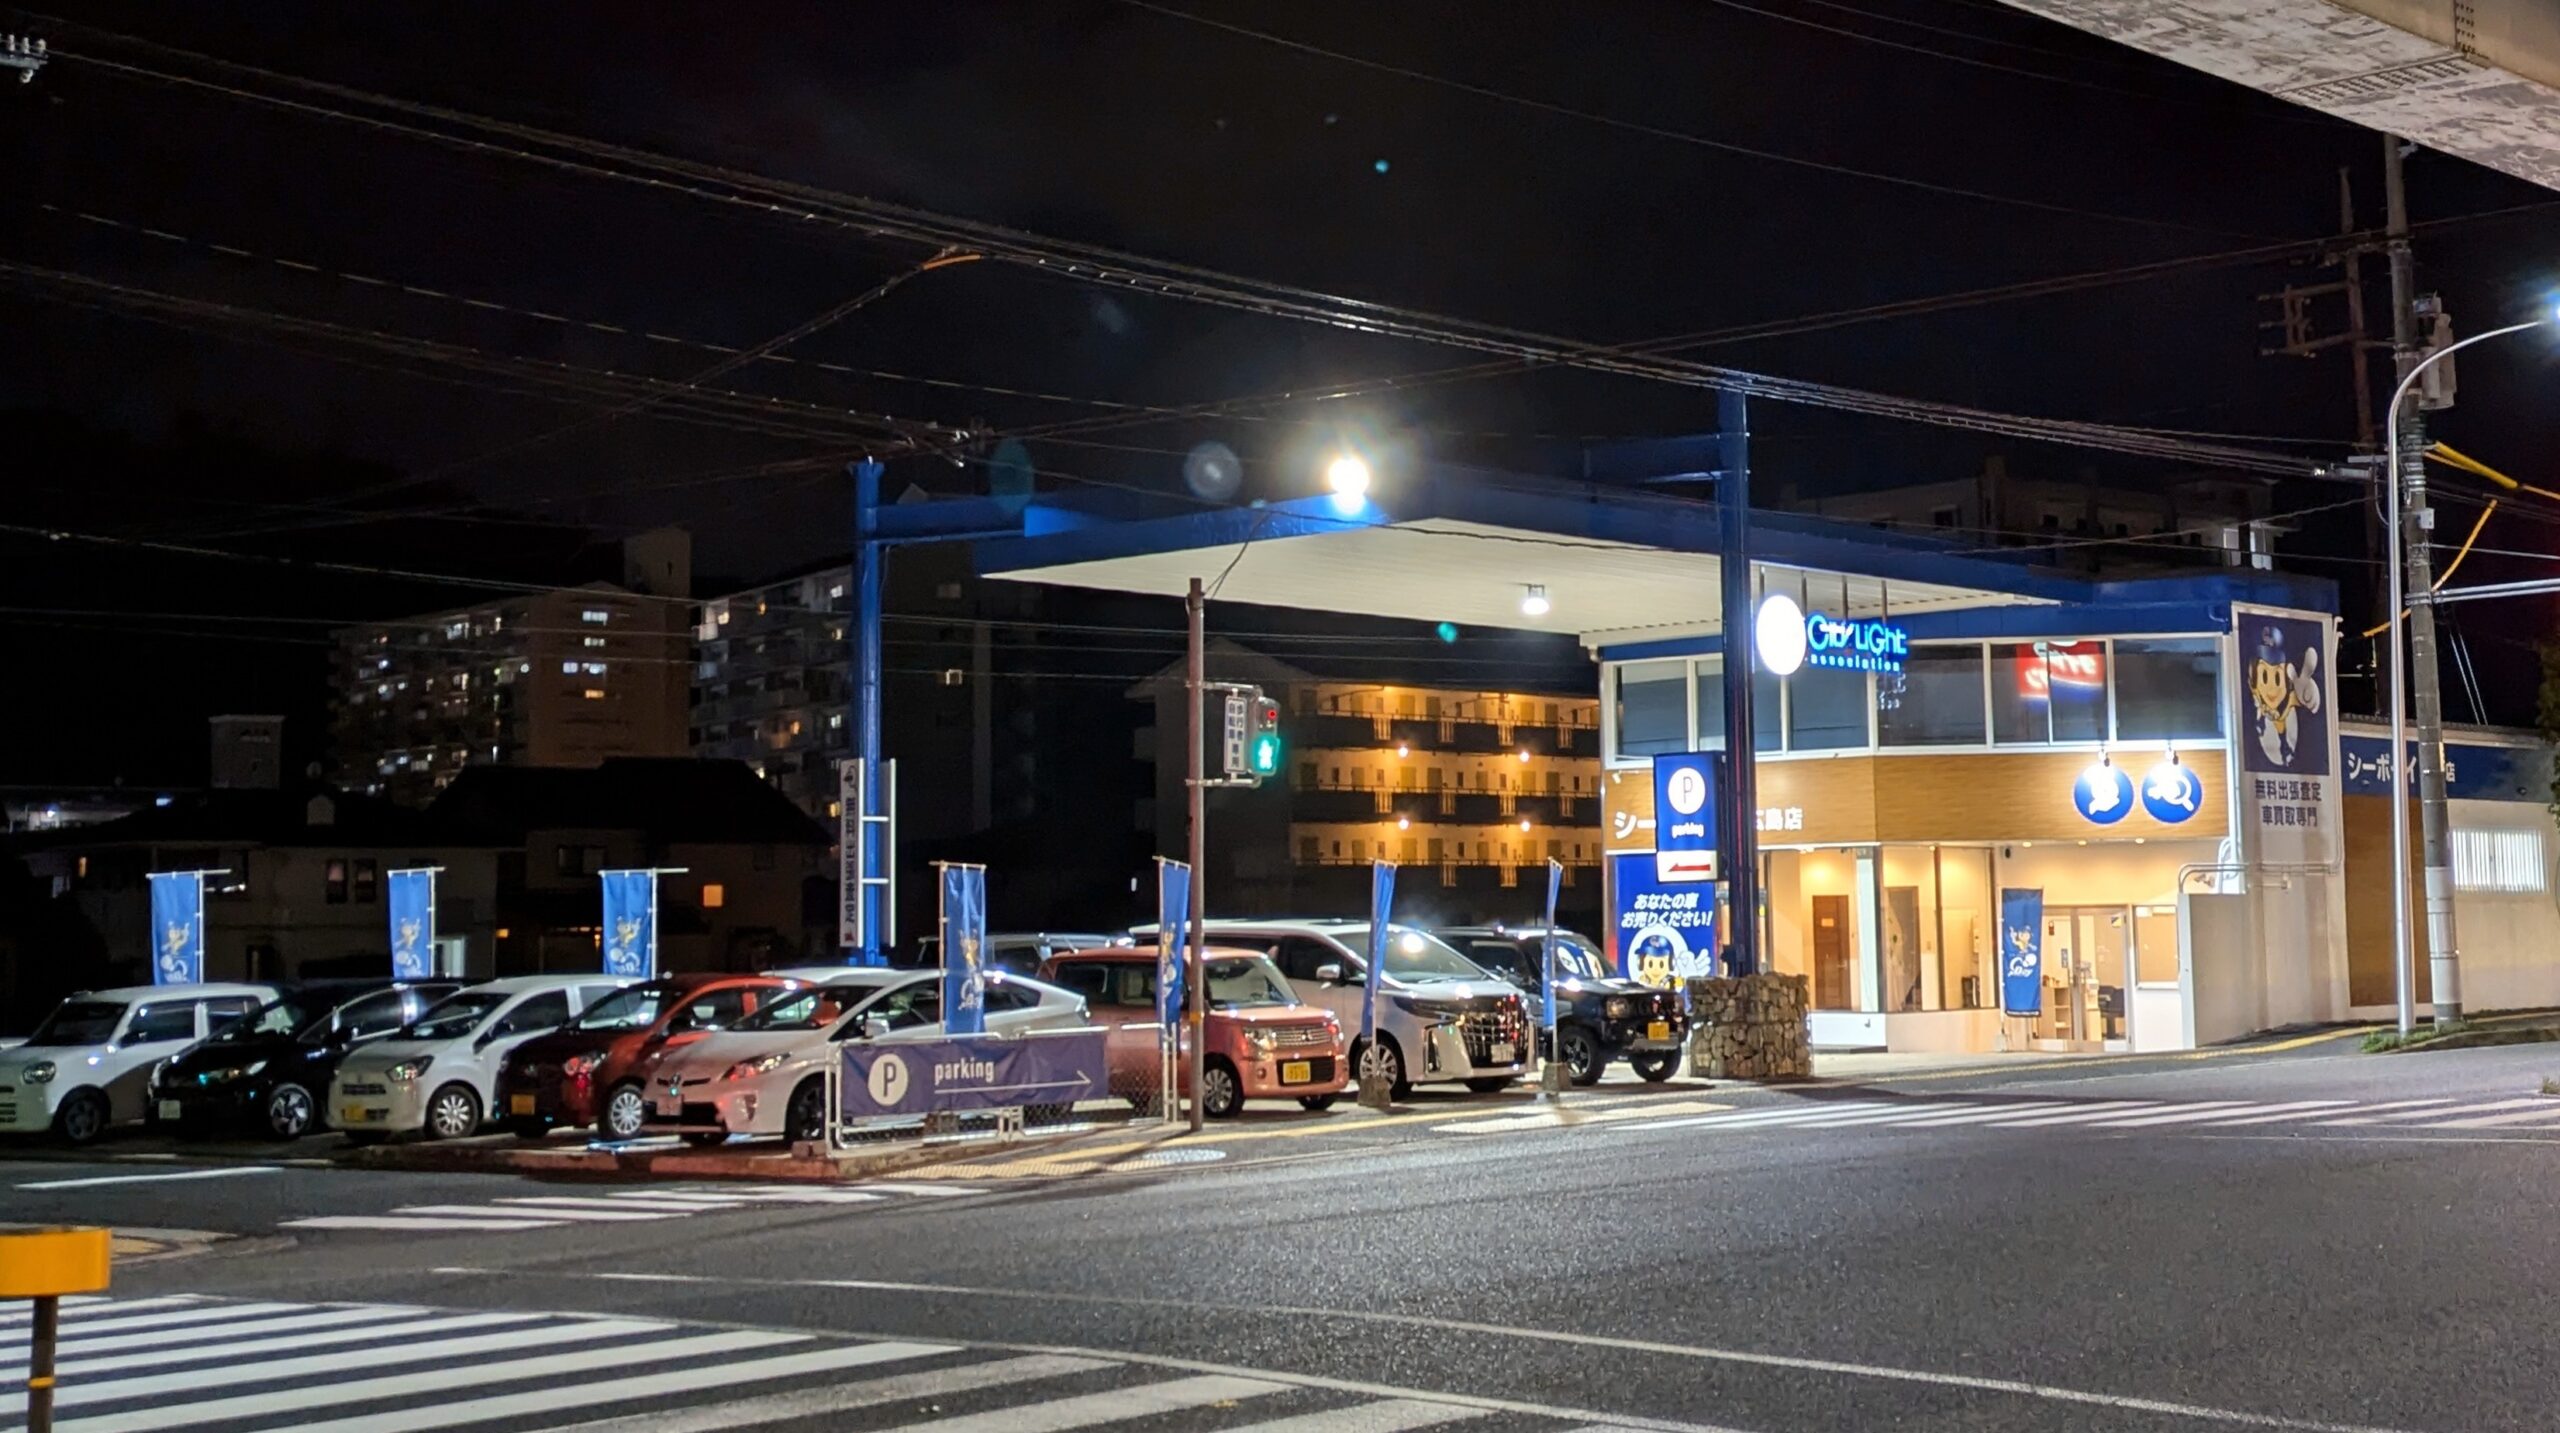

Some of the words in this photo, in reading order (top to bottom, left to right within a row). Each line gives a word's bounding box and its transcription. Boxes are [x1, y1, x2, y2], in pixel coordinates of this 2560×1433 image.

[1682, 776, 1694, 804] P
[2255, 778, 2322, 802] 無料出張査定
[2261, 804, 2318, 827] 車買取専門
[1634, 892, 1700, 910] あなたの車
[883, 1061, 897, 1097] P
[934, 1057, 995, 1085] parking
